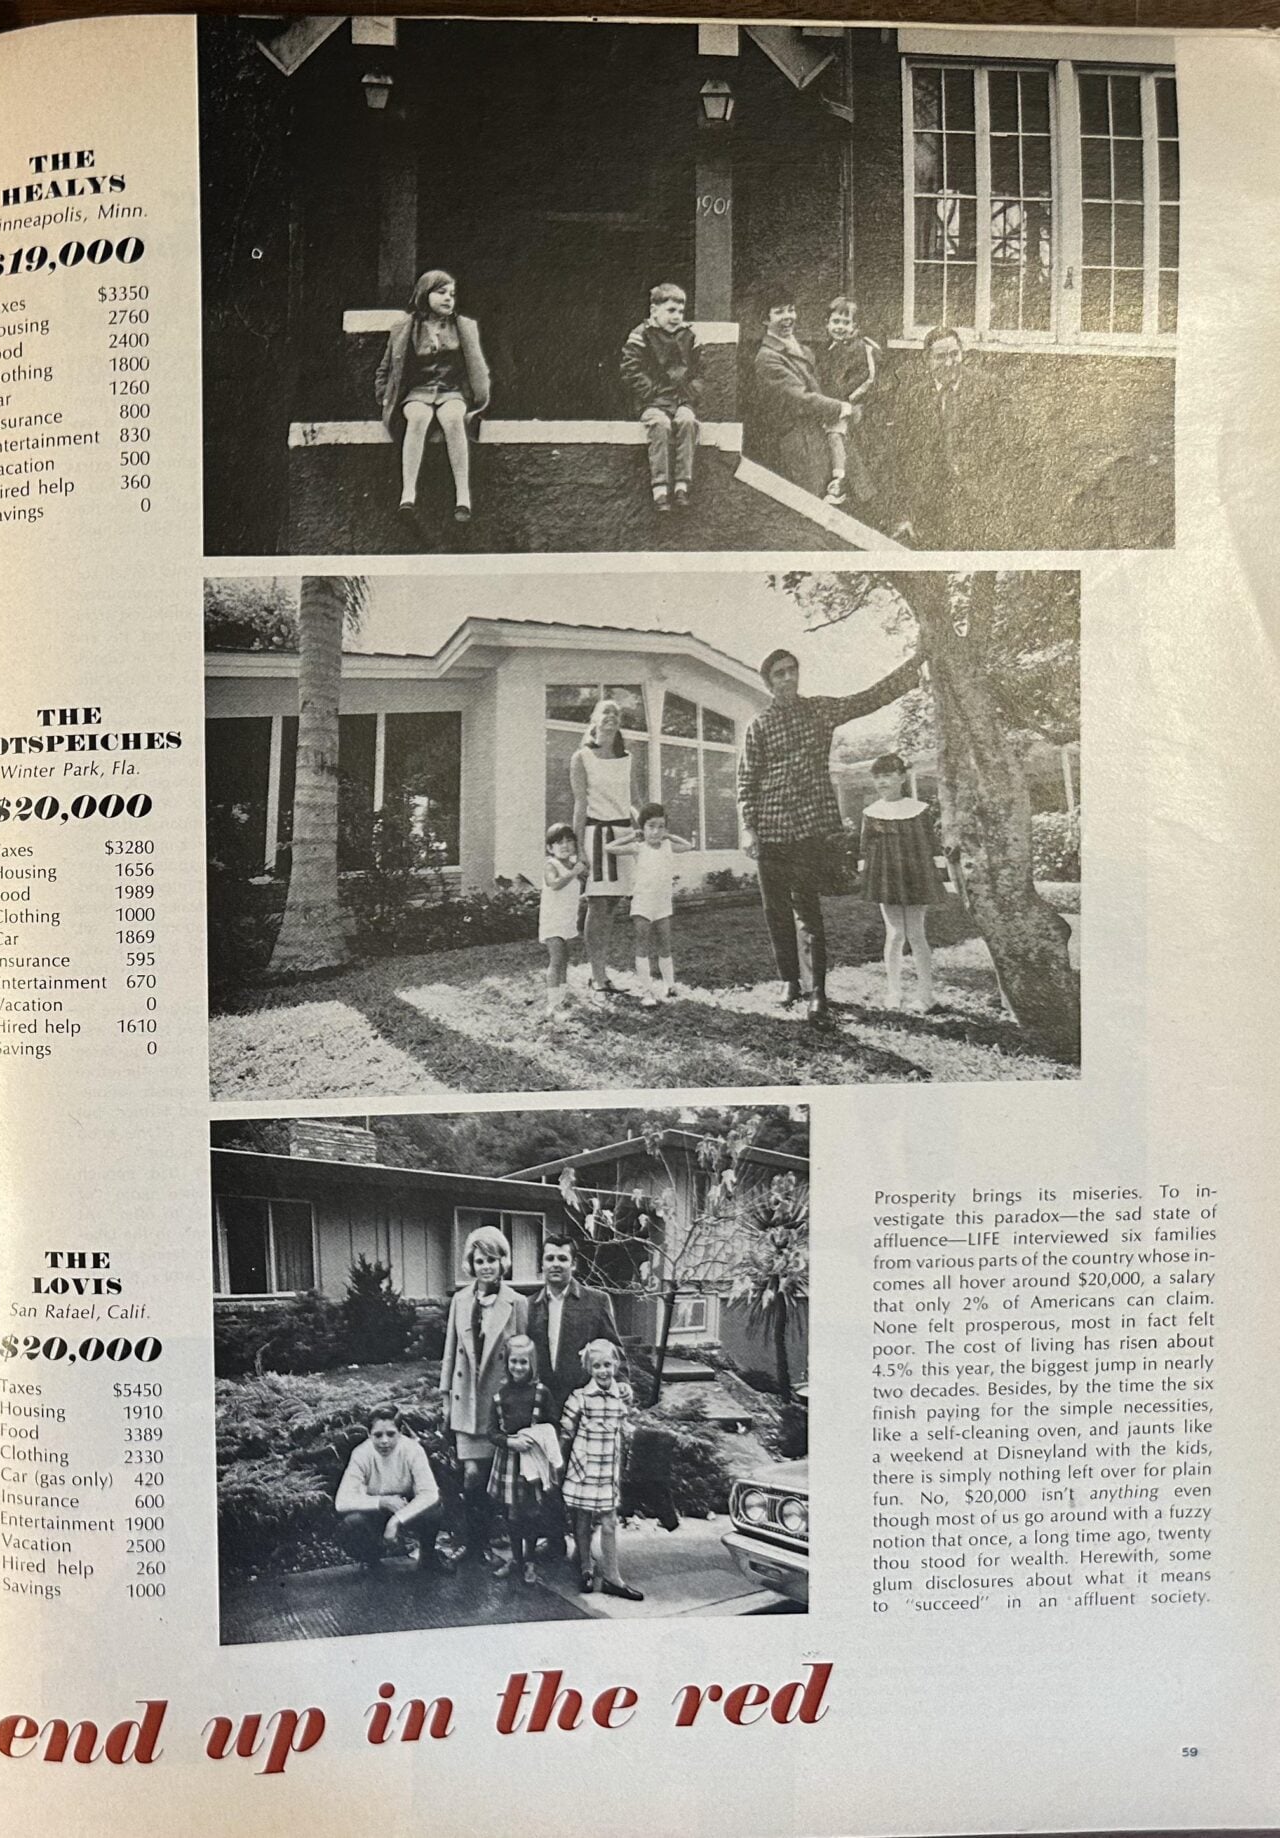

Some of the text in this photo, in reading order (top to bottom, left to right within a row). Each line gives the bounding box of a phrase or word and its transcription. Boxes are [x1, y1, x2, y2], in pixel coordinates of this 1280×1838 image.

[29, 150, 95, 173] THE
[1, 175, 126, 207] HEALYS
[98, 204, 148, 221] Minn.
[108, 309, 149, 325] 2760
[109, 380, 149, 395] 1260
[120, 451, 150, 466] 500
[141, 498, 151, 512] 0
[37, 707, 101, 726] THE
[1, 760, 139, 779] Winter Park, Fla.
[105, 840, 154, 856] $3280
[116, 907, 155, 921] 1000
[127, 974, 156, 988] 670
[147, 1041, 157, 1055] 0
[875, 1184, 1217, 1207] Prosperity brings its miseries. To in-
[45, 1251, 110, 1269] THE
[874, 1248, 1215, 1271] from various parts of the country whose in-
[32, 1277, 122, 1295] LOVIS
[10, 1303, 150, 1321] San Rafael, Calif.
[874, 1290, 1214, 1315] that only 2% of Americans can claim.
[0, 1334, 162, 1366] $20,000
[872, 1354, 1214, 1379] 4.5% this year, the biggest jump in nearly
[872, 1398, 1213, 1422] finish paying for the simple necessities,
[1, 1467, 164, 1491] Car (gas only) 420
[873, 1461, 1211, 1486] there is simply nothing left over for plain
[2, 1489, 165, 1509] Insurance 600
[3, 1555, 166, 1579] Hired help 260
[201, 1705, 326, 1774] up
[364, 1683, 455, 1745] in
[497, 1670, 638, 1735] the
[672, 1663, 833, 1727] red
[1182, 1747, 1198, 1757] 59
